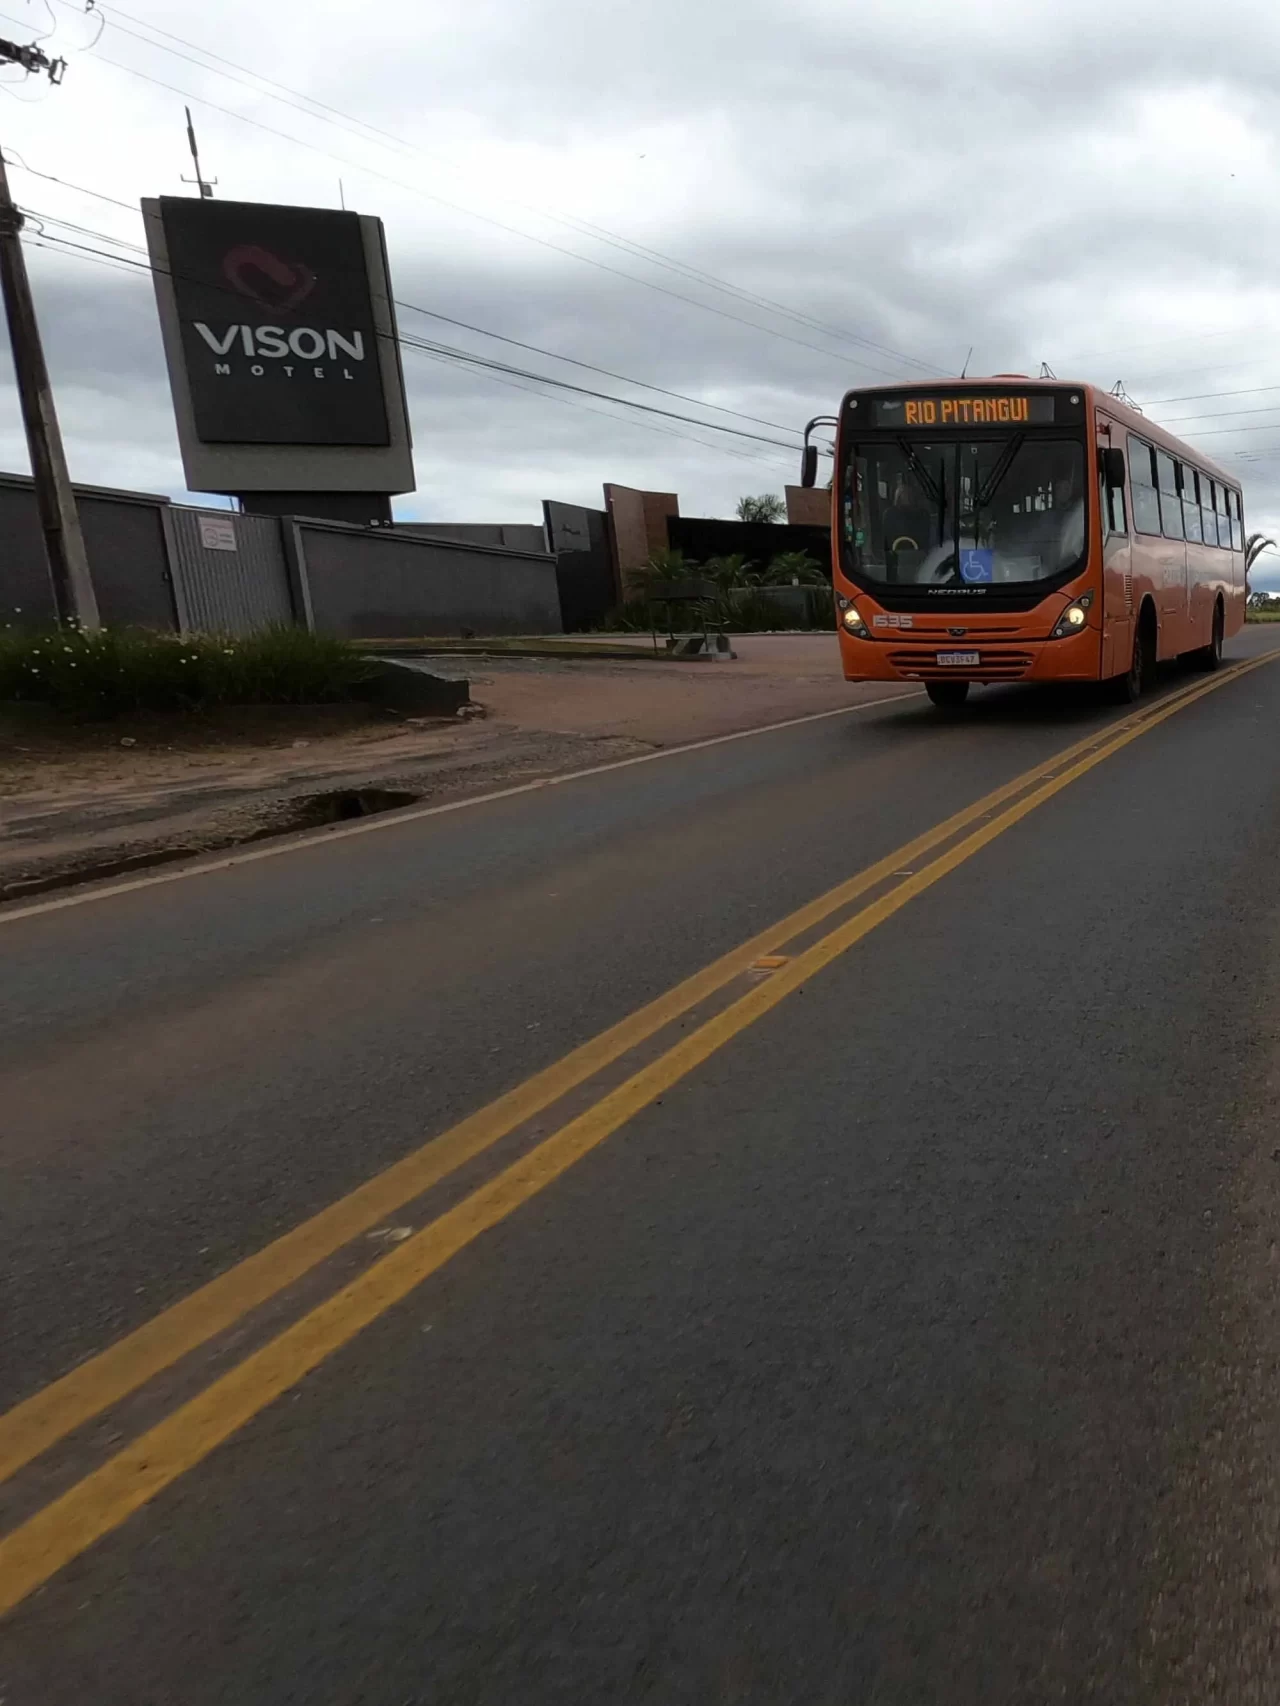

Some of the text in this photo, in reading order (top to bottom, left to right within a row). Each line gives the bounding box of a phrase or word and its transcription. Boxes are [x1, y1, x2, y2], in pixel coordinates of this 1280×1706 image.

[193, 321, 365, 361] VISON
[214, 363, 354, 380] MOTEL
[904, 397, 1028, 424] RIO PITANGUI
